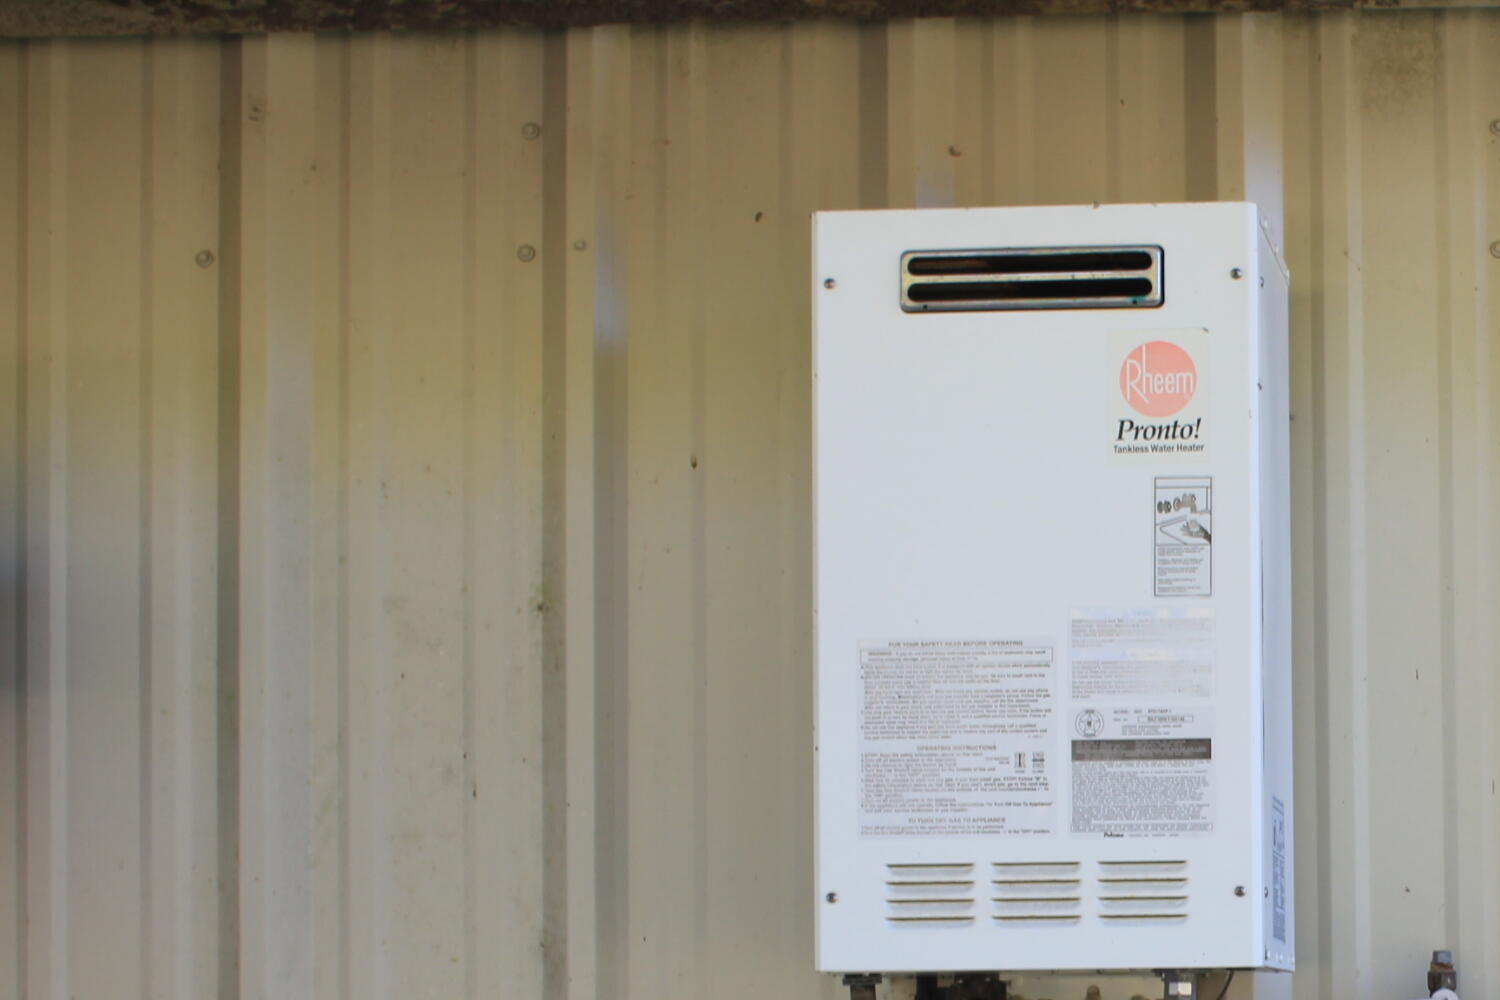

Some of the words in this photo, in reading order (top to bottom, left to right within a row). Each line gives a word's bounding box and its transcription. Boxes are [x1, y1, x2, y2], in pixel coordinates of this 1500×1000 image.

[1126, 343, 1194, 405] Rheem
[1115, 417, 1202, 441] Pronto!
[1113, 444, 1149, 454] Tankless
[1150, 443, 1175, 453] Water
[1176, 442, 1205, 453] Heater
